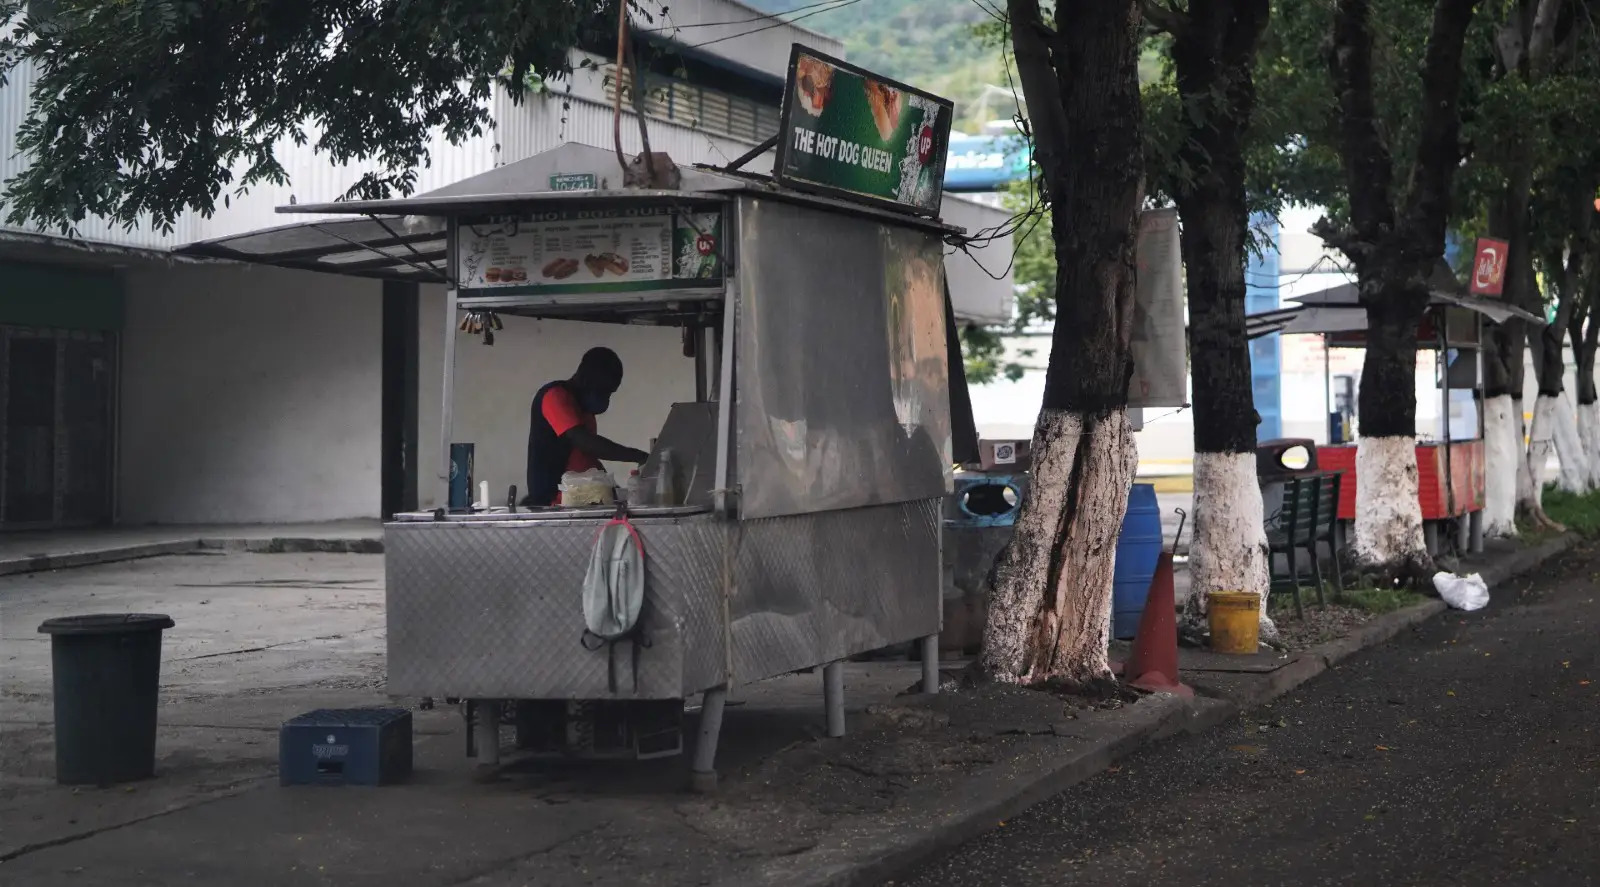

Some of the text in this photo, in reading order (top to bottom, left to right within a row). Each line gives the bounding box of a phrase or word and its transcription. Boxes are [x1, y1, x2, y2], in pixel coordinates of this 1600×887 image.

[794, 126, 893, 174] THE HOT DOG QUEEN
[920, 136, 933, 156] UP
[531, 211, 569, 222] HOT
[577, 208, 618, 219] DOG
